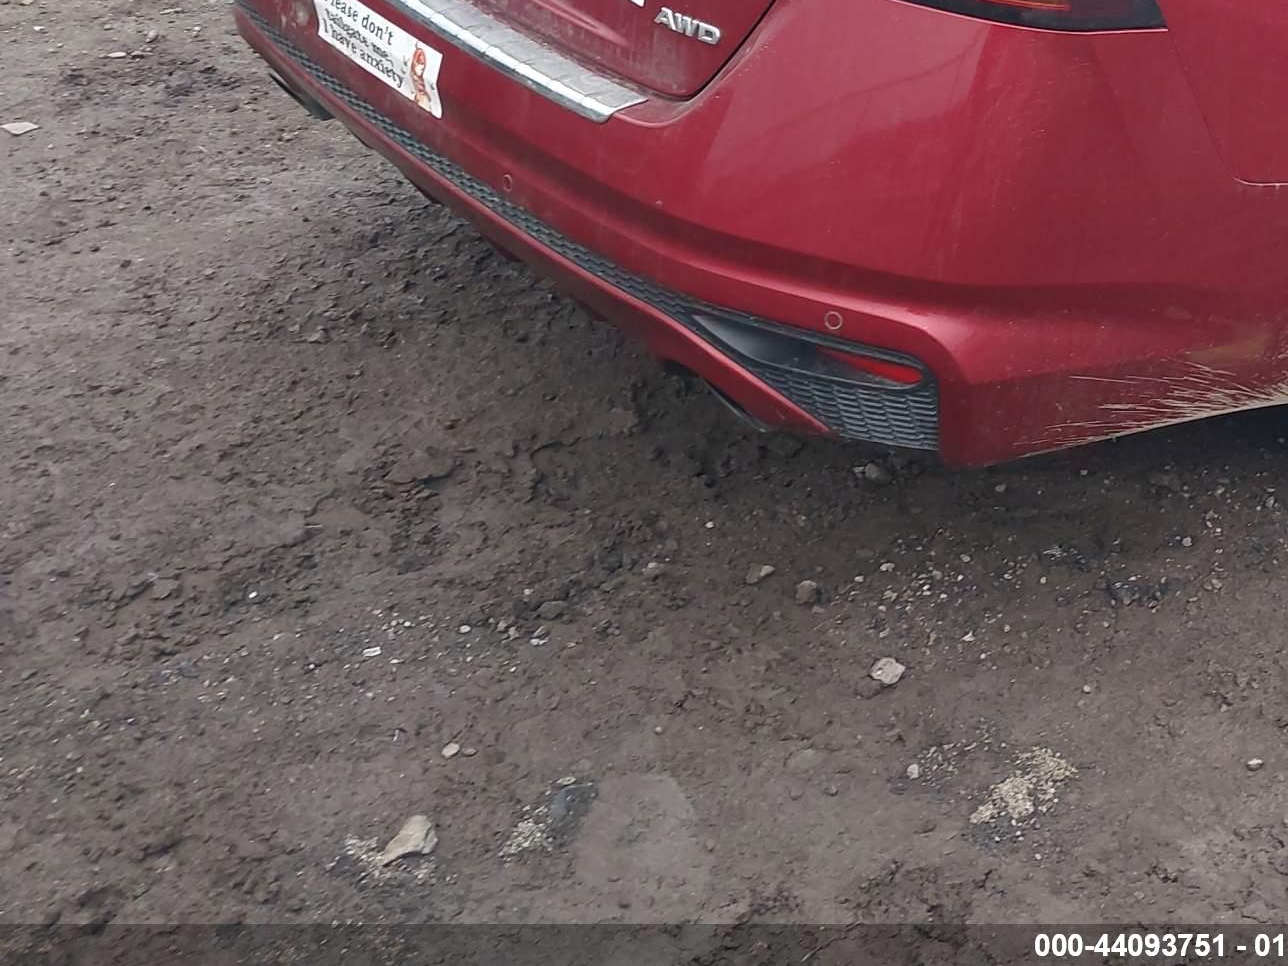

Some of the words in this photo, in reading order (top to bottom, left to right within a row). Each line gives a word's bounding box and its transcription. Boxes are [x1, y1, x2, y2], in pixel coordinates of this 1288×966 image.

[361, 14, 395, 46] don't
[653, 6, 721, 45] AWD
[321, 17, 329, 34] I
[329, 23, 358, 55] have
[359, 49, 405, 89] anxiety
